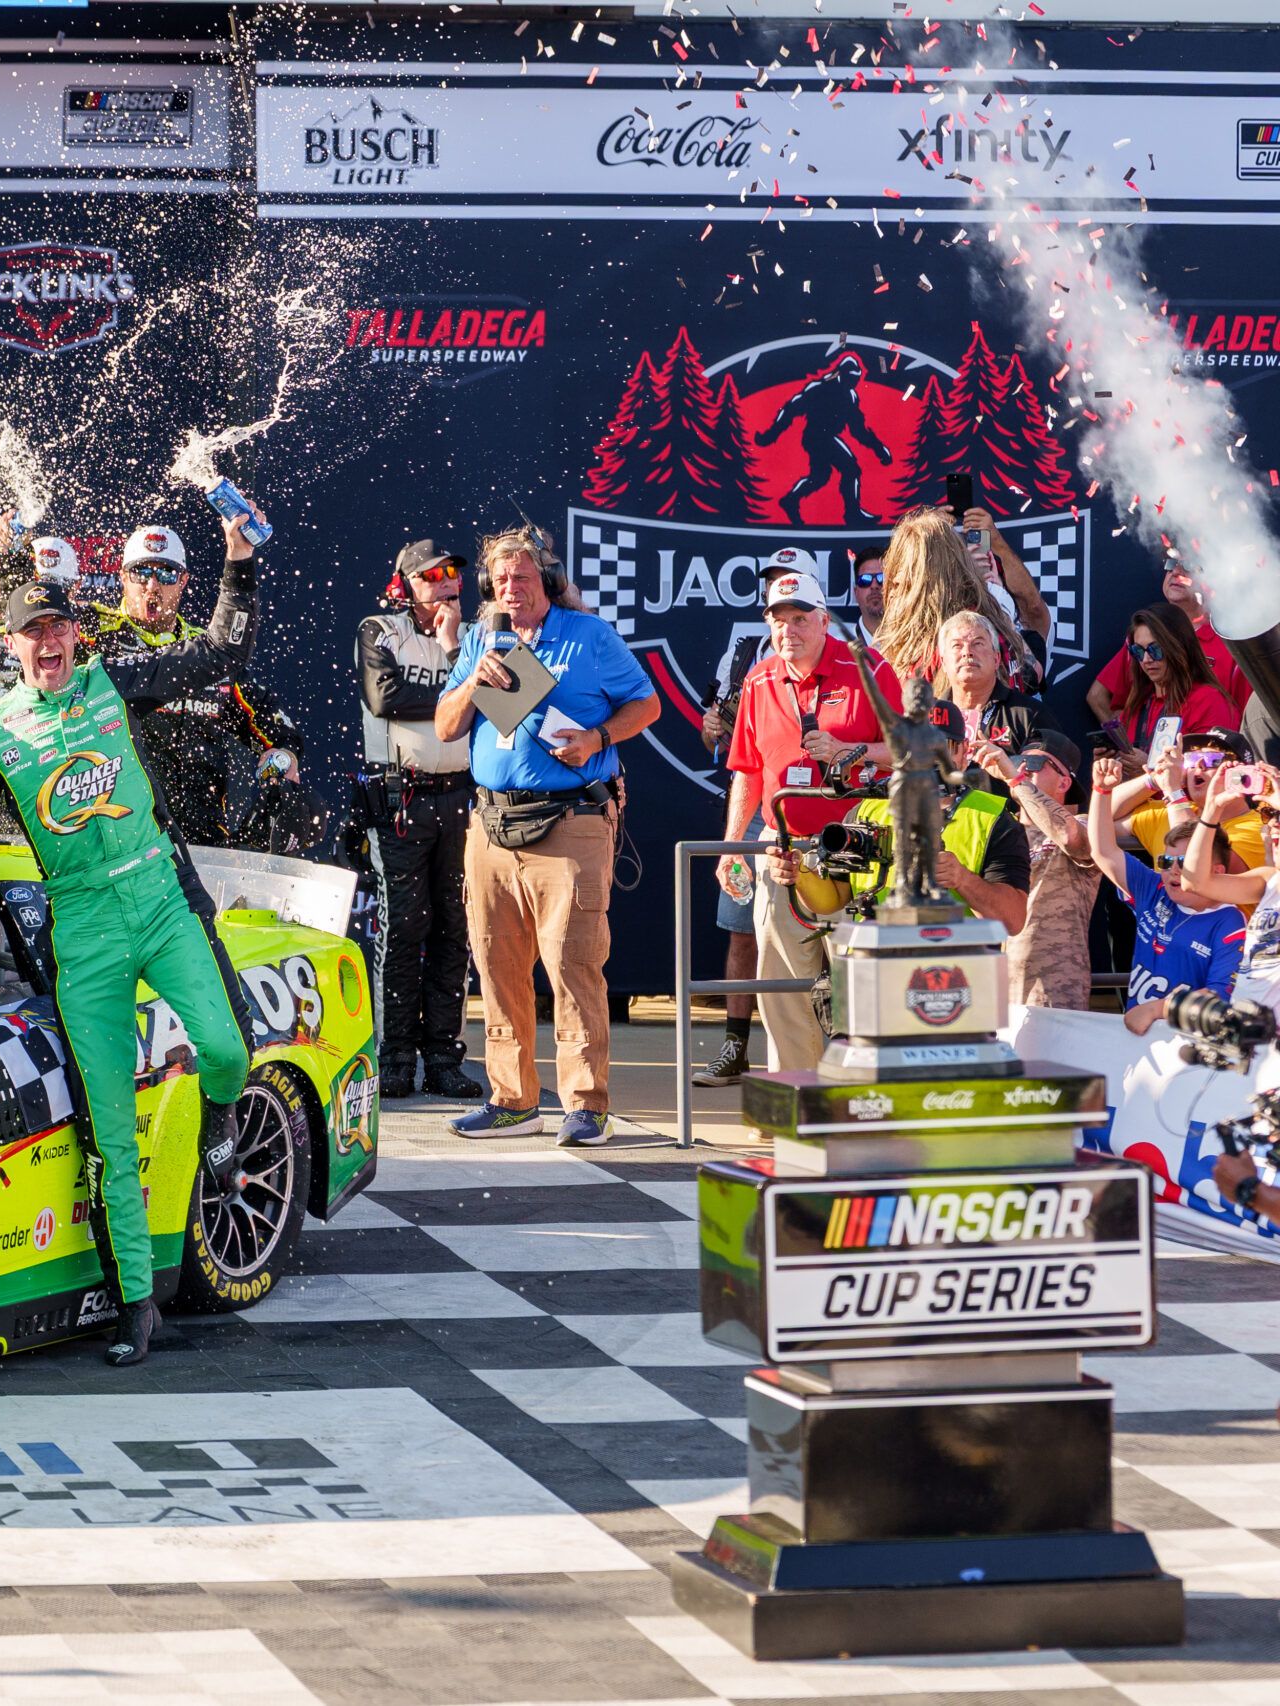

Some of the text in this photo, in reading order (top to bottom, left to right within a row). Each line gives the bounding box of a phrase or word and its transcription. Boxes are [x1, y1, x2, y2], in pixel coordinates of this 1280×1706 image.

[105, 91, 172, 110] NASCAR
[82, 116, 173, 135] CUP SERIES
[305, 126, 439, 168] BUSCH
[596, 114, 762, 169] Coca-Cola
[896, 115, 1071, 172] xfinity
[333, 168, 410, 185] LIGHT
[40, 270, 135, 304] LINK'S
[346, 308, 546, 348] TALLADEGA
[371, 349, 528, 364] SUPERSPEEDWAY
[496, 634, 518, 644] MRN
[399, 664, 450, 688] OFFIC
[104, 720, 122, 733] DELTA
[1, 749, 20, 766] PPG
[54, 755, 123, 798] QUAKER
[68, 774, 116, 806] STATE
[108, 857, 142, 878] CINDRIC
[11, 889, 29, 900] Ford
[22, 908, 41, 925] PPG
[902, 1048, 979, 1060] WINNER
[260, 1065, 302, 1113] EAGLE
[345, 1074, 380, 1104] QUAKER
[922, 1090, 977, 1111] Coca-Cola
[1003, 1086, 1063, 1108] xfinity
[348, 1098, 375, 1120] STATE
[848, 1097, 894, 1114] BUSCH
[42, 1143, 70, 1161] KIDDE
[210, 1139, 234, 1164] OMP
[888, 1187, 1094, 1247] NASCAR
[193, 1220, 273, 1303] GOODYEAR
[824, 1262, 1098, 1320] CUP SERIES
[172, 1440, 259, 1470] 1
[70, 1499, 400, 1525] LANE
